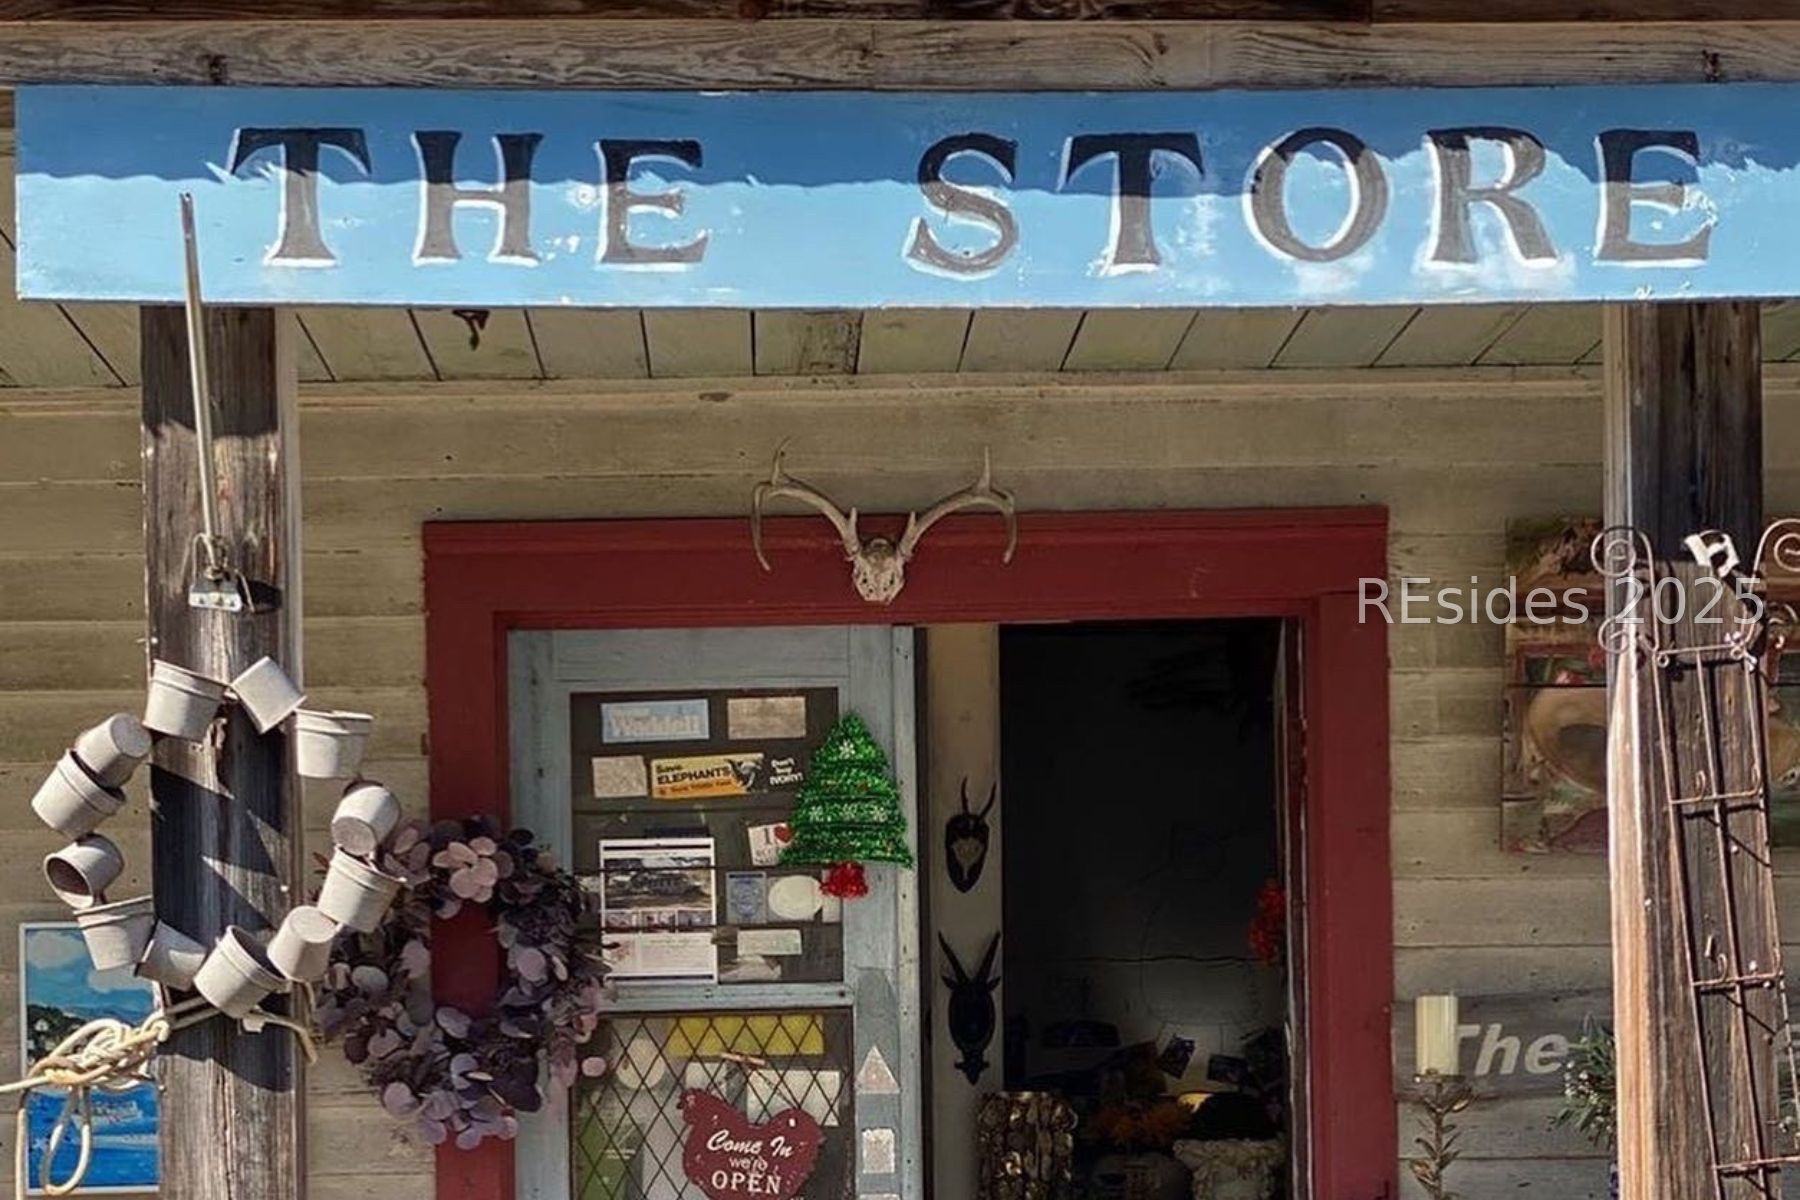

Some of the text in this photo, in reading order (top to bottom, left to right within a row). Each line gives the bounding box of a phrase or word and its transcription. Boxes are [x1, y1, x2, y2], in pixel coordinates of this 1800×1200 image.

[229, 126, 1716, 277] THE STORE
[706, 1129, 795, 1158] Come In
[711, 1169, 781, 1195] OPEN
